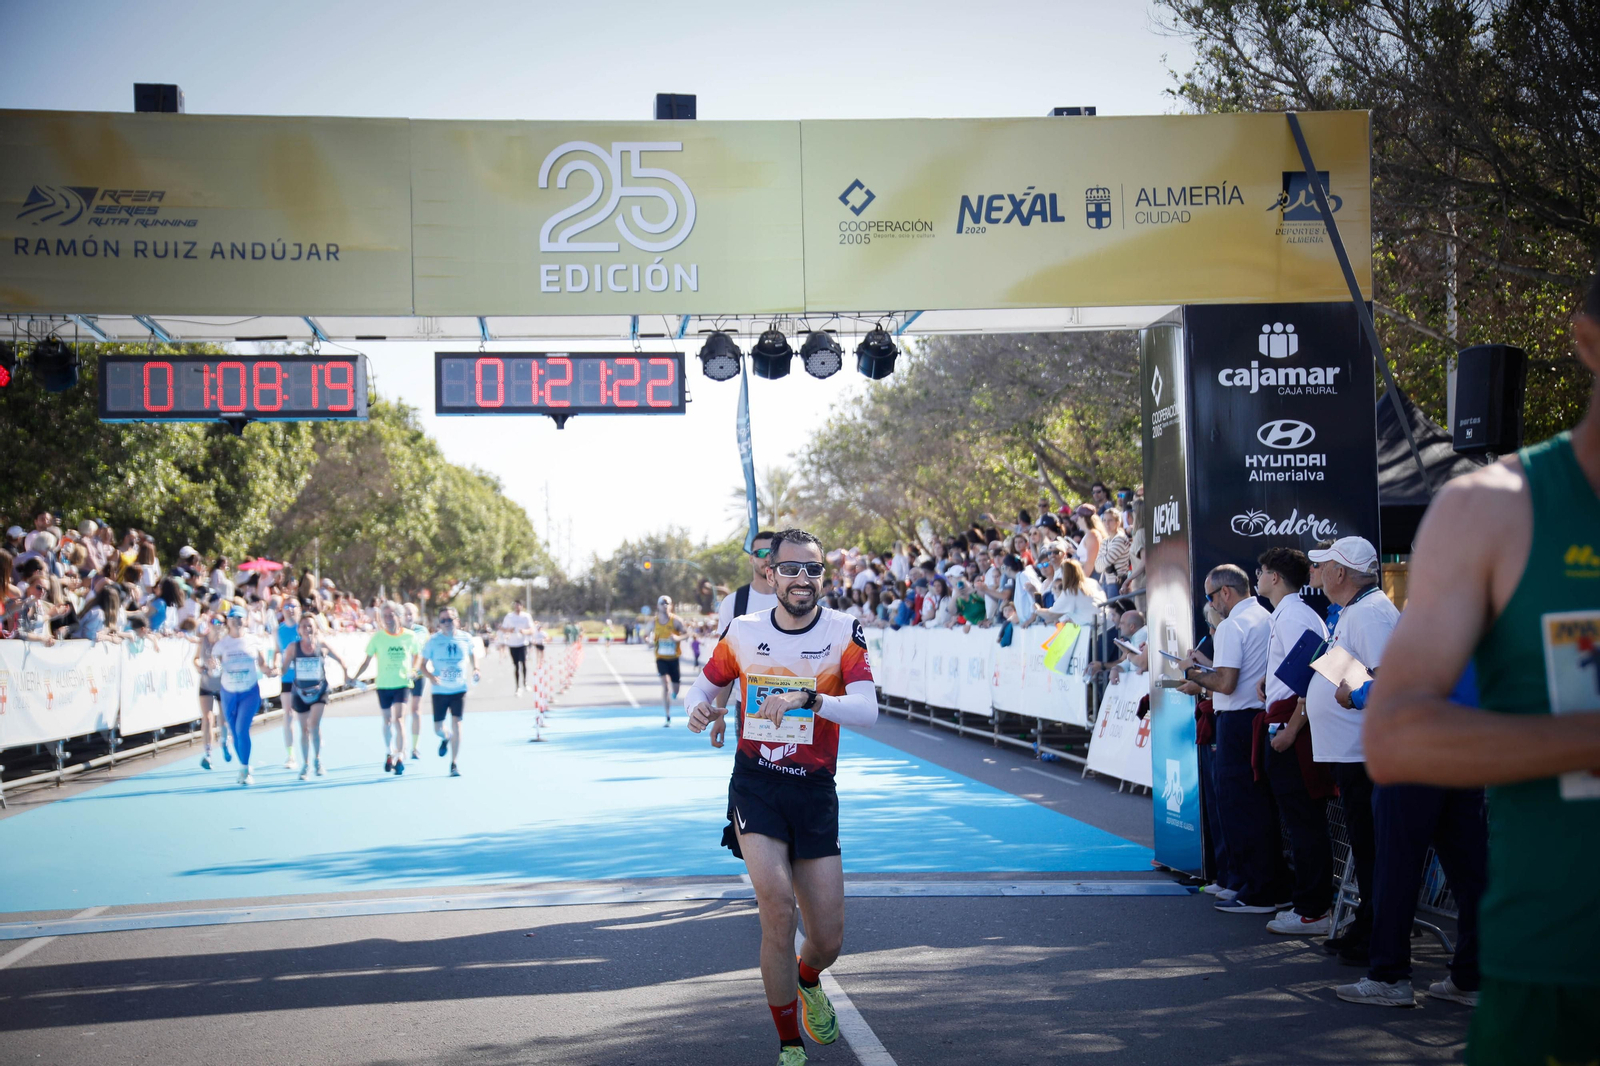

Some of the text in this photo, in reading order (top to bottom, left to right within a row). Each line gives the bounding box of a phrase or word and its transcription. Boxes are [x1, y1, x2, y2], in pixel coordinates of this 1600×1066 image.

[100, 189, 166, 204] RFEA
[538, 140, 697, 252] 25
[1135, 180, 1244, 207] ALMERÍA
[93, 204, 160, 217] SERIES
[1135, 211, 1191, 224] CIUDAD
[88, 217, 198, 228] RUTA RUNNING
[839, 218, 933, 232] COOPERACIÓN
[965, 226, 987, 234] 2020
[839, 233, 871, 245] 2005
[14, 234, 340, 261] RAMÓN RUIZ ANDÚJAR
[540, 257, 699, 292] EDICIÓN
[1218, 360, 1340, 394] cajamar
[1278, 386, 1338, 395] CAJA RURAL
[1245, 453, 1326, 468] HYUNDAI
[1249, 469, 1325, 482] Almerialva
